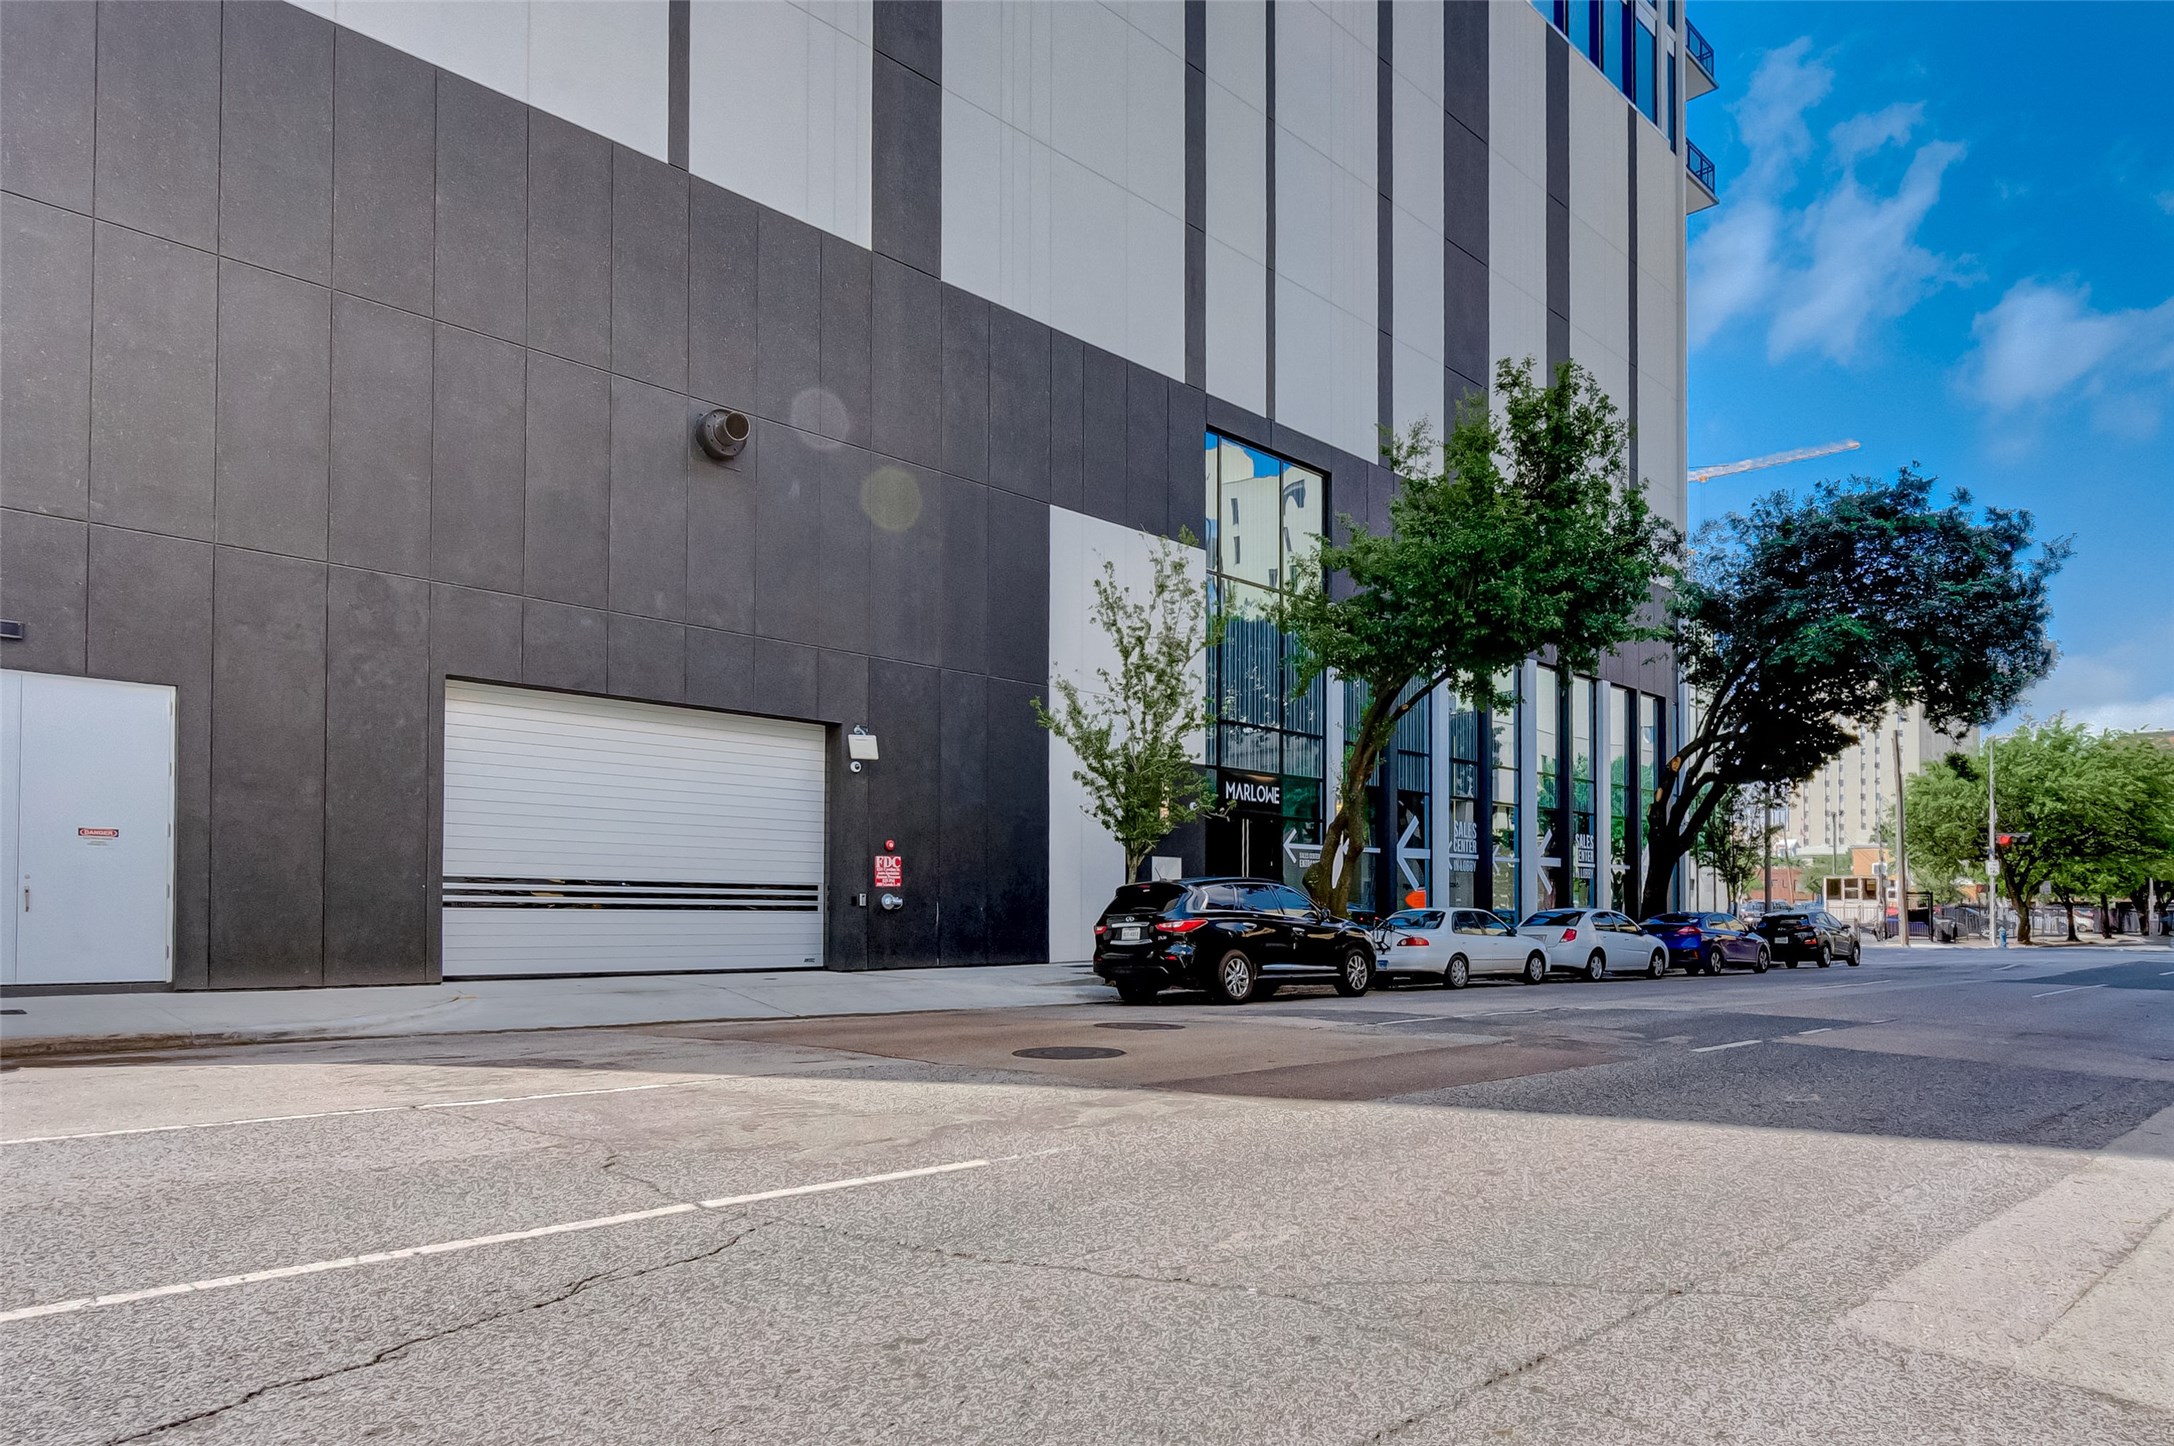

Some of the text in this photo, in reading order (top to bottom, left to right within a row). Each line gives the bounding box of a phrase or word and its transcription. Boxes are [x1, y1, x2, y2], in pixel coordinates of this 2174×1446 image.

[1225, 780, 1280, 804] MARLOWE
[1454, 820, 1477, 839] SALES
[1454, 839, 1477, 854] CENTER
[1575, 833, 1594, 849] SALES
[876, 855, 902, 868] FDC
[1460, 859, 1477, 872] LOBBY
